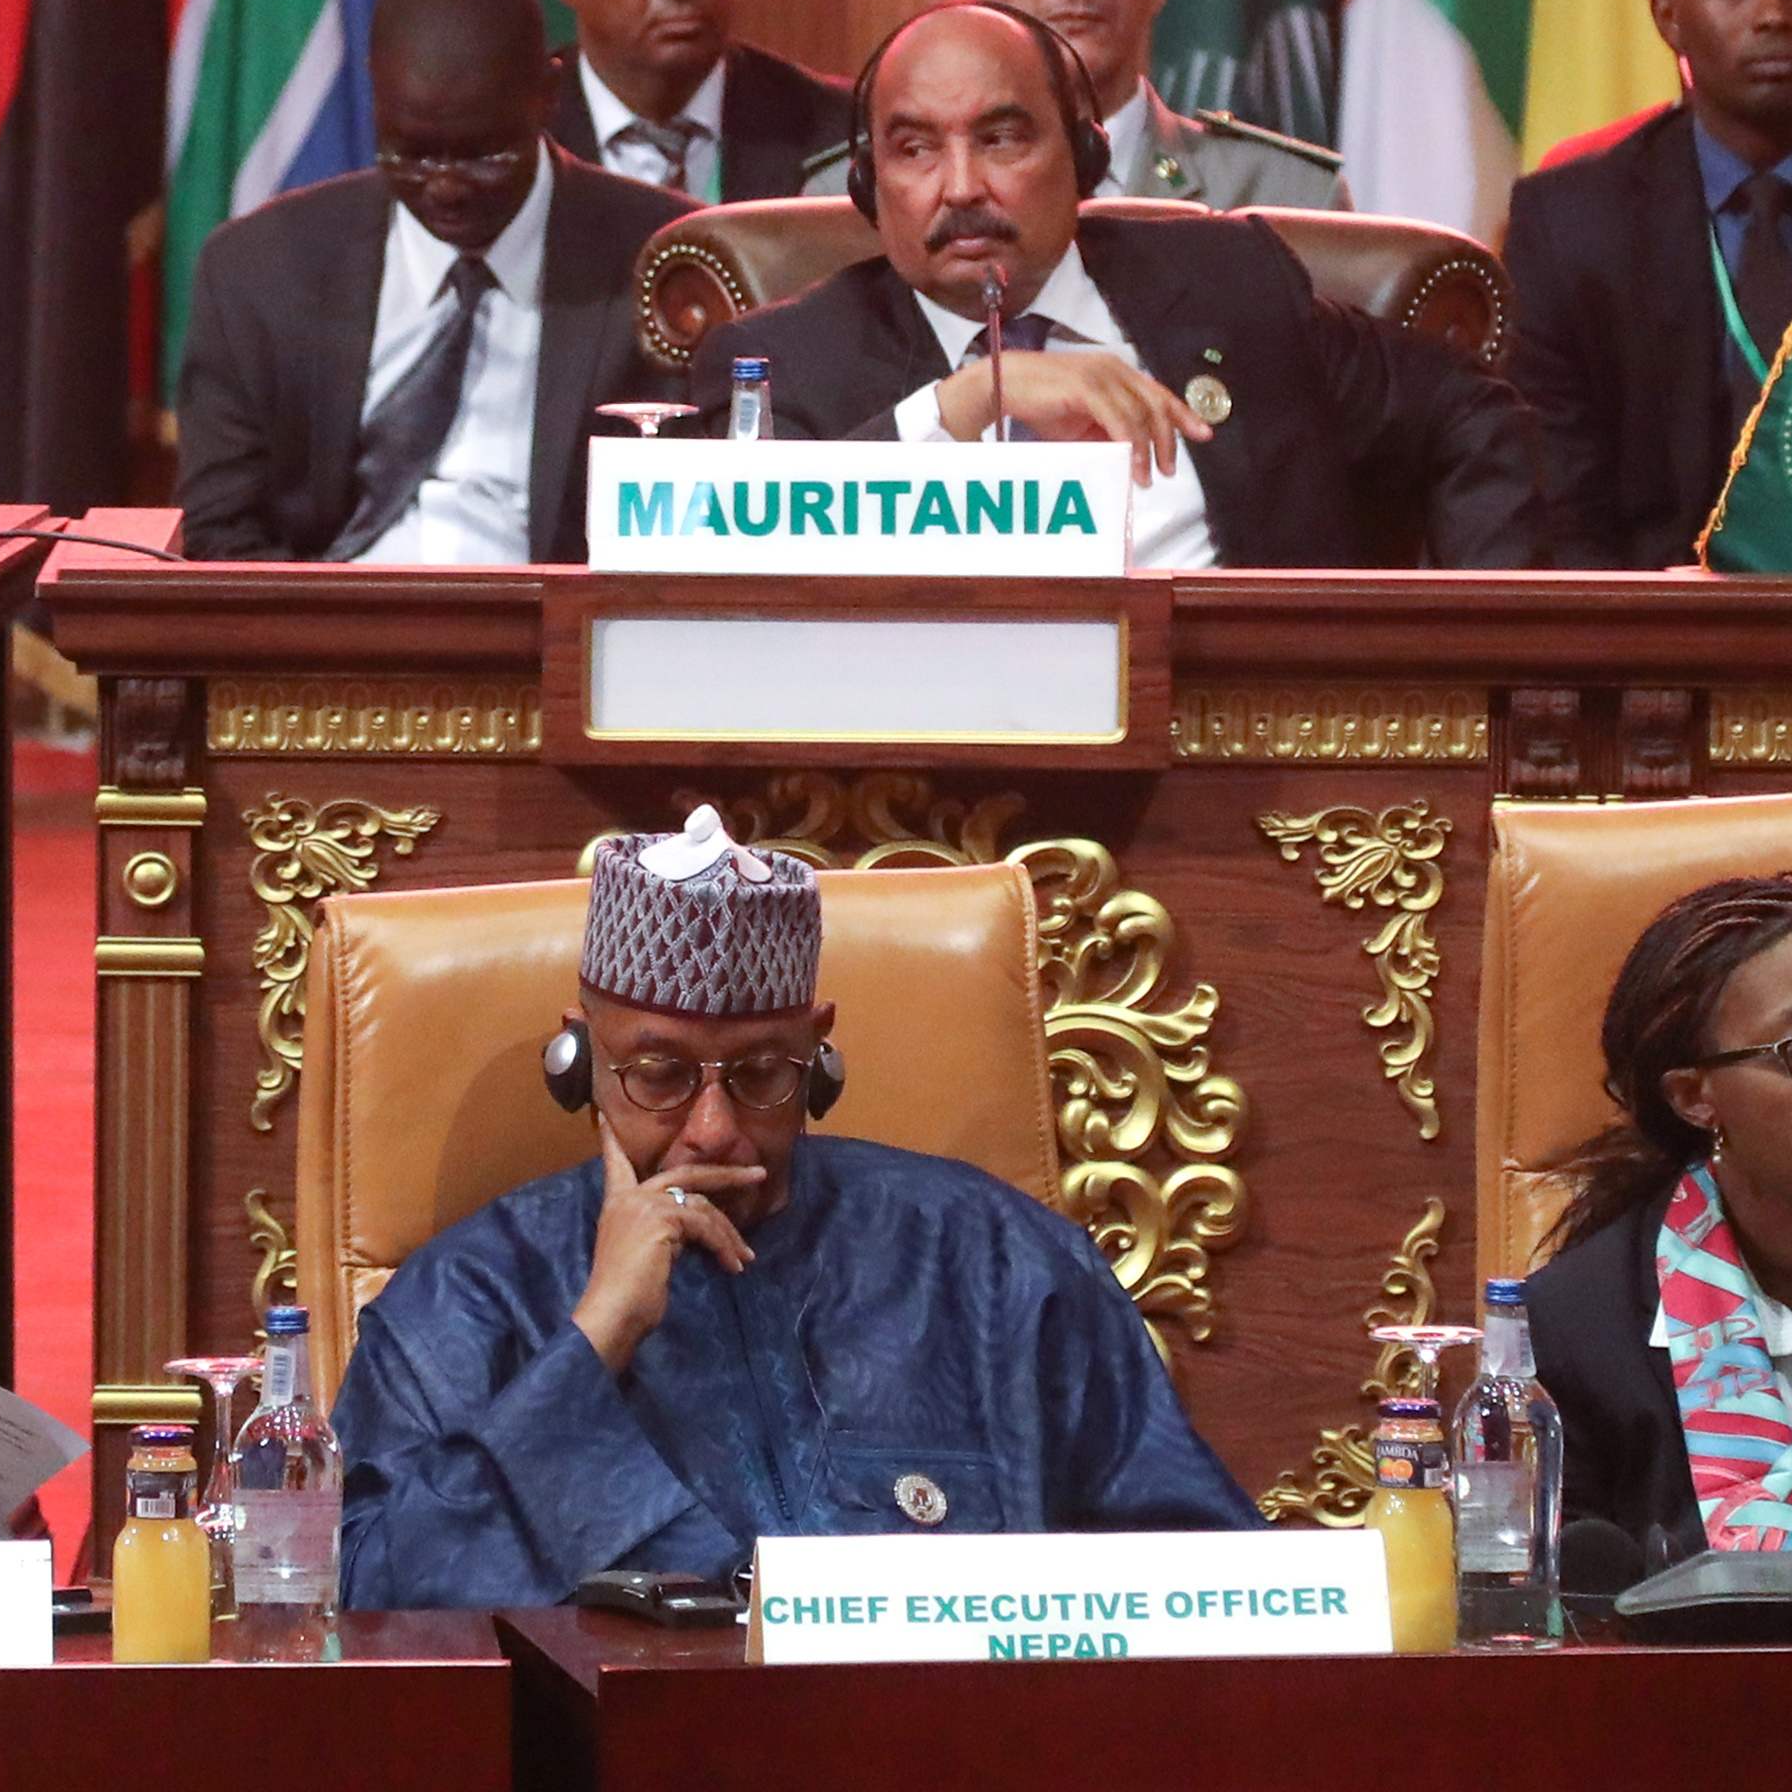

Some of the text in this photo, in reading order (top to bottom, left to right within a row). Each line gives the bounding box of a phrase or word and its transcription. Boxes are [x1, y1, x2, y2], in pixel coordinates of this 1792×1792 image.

[617, 480, 1098, 537] MAURITANIA
[763, 1586, 1348, 1624] CHIEF EXECUTIVE OFFICER
[988, 1633, 1129, 1661] NEPAD
